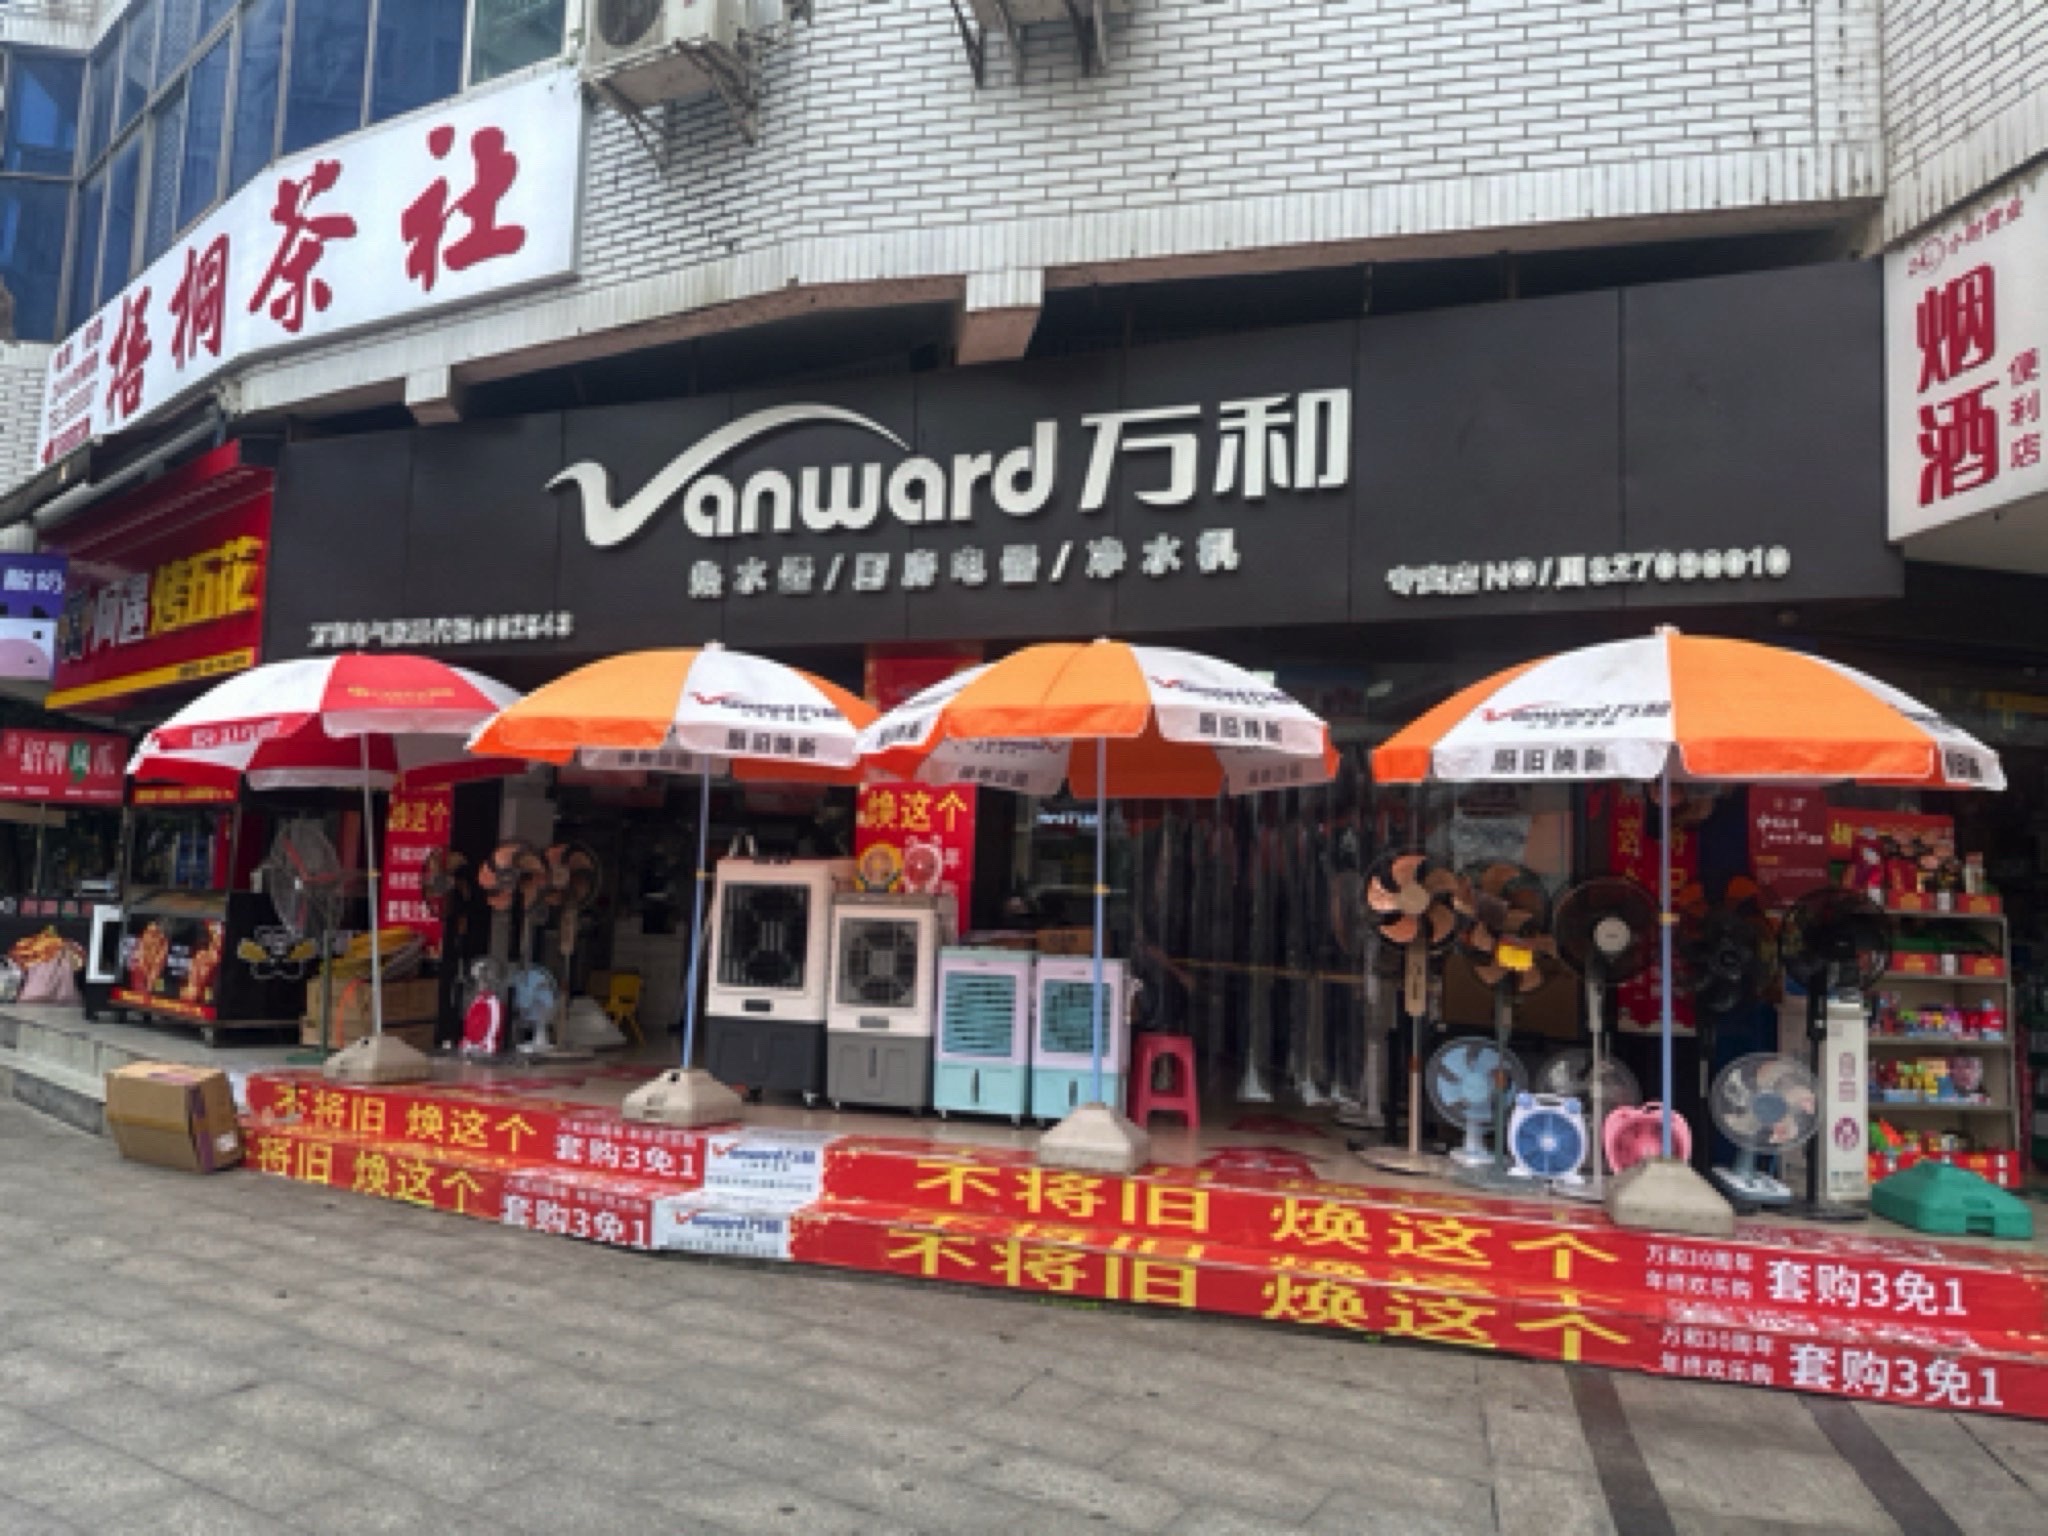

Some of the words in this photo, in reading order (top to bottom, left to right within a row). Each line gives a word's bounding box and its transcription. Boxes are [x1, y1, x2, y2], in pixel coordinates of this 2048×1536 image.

[106, 126, 525, 428] 梧桐茶社
[1916, 263, 2000, 507] 烟酒
[2008, 347, 2042, 468] 便利店
[546, 403, 1058, 548] Vanward
[1081, 388, 1351, 513] 万和
[914, 1161, 1212, 1231] 不将旧
[1270, 1198, 1620, 1279] 焕这个
[888, 1228, 1200, 1308] 不将旧
[1261, 1278, 1632, 1362] 焕这个
[1766, 1259, 1969, 1317] 套购3免1
[1789, 1342, 2004, 1407] 套购3免1
